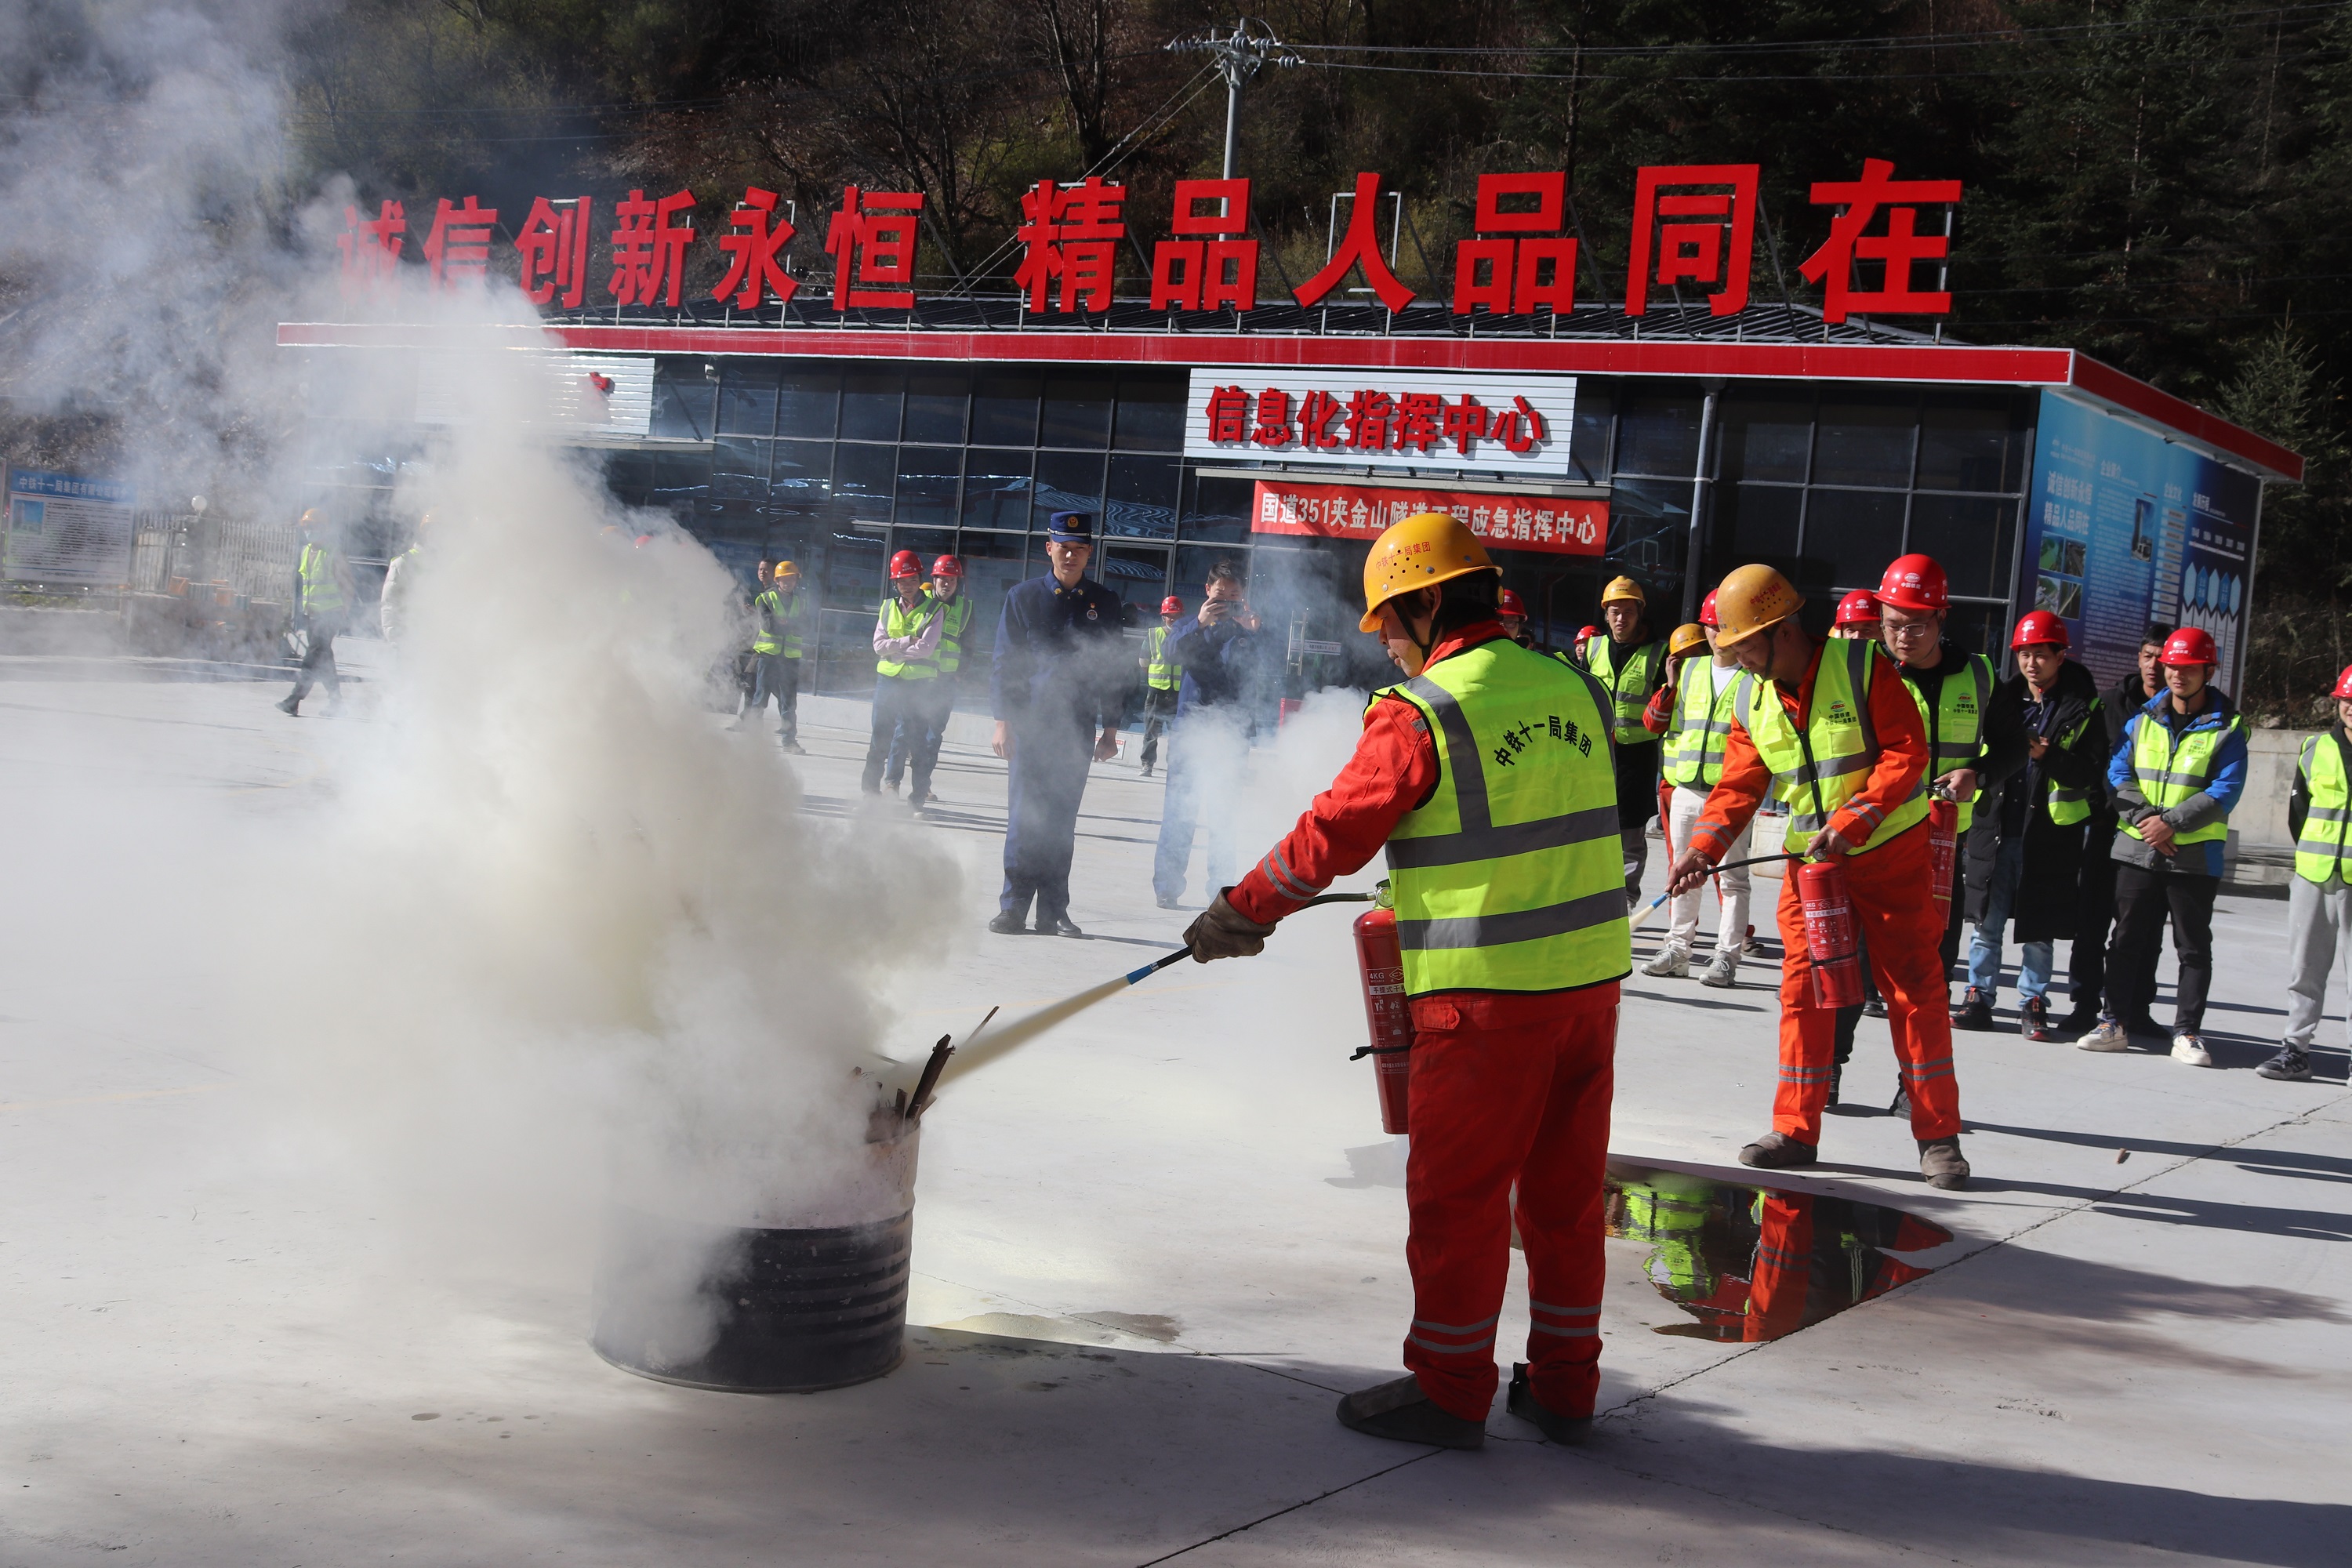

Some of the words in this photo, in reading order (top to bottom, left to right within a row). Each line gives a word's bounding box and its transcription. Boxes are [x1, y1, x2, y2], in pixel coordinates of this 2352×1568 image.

[336, 186, 925, 311] 诚信创新永恒
[1014, 158, 1963, 324] 精品人品同在
[1205, 384, 1544, 455] 信息化指挥中心
[1261, 492, 1597, 545] 国道351夹金山隧程应急指挥中心
[2044, 501, 2090, 535] 精品人品同在
[1375, 541, 1431, 571] 中铁十一局集团
[1494, 715, 1592, 767] 中铁十一局集团
